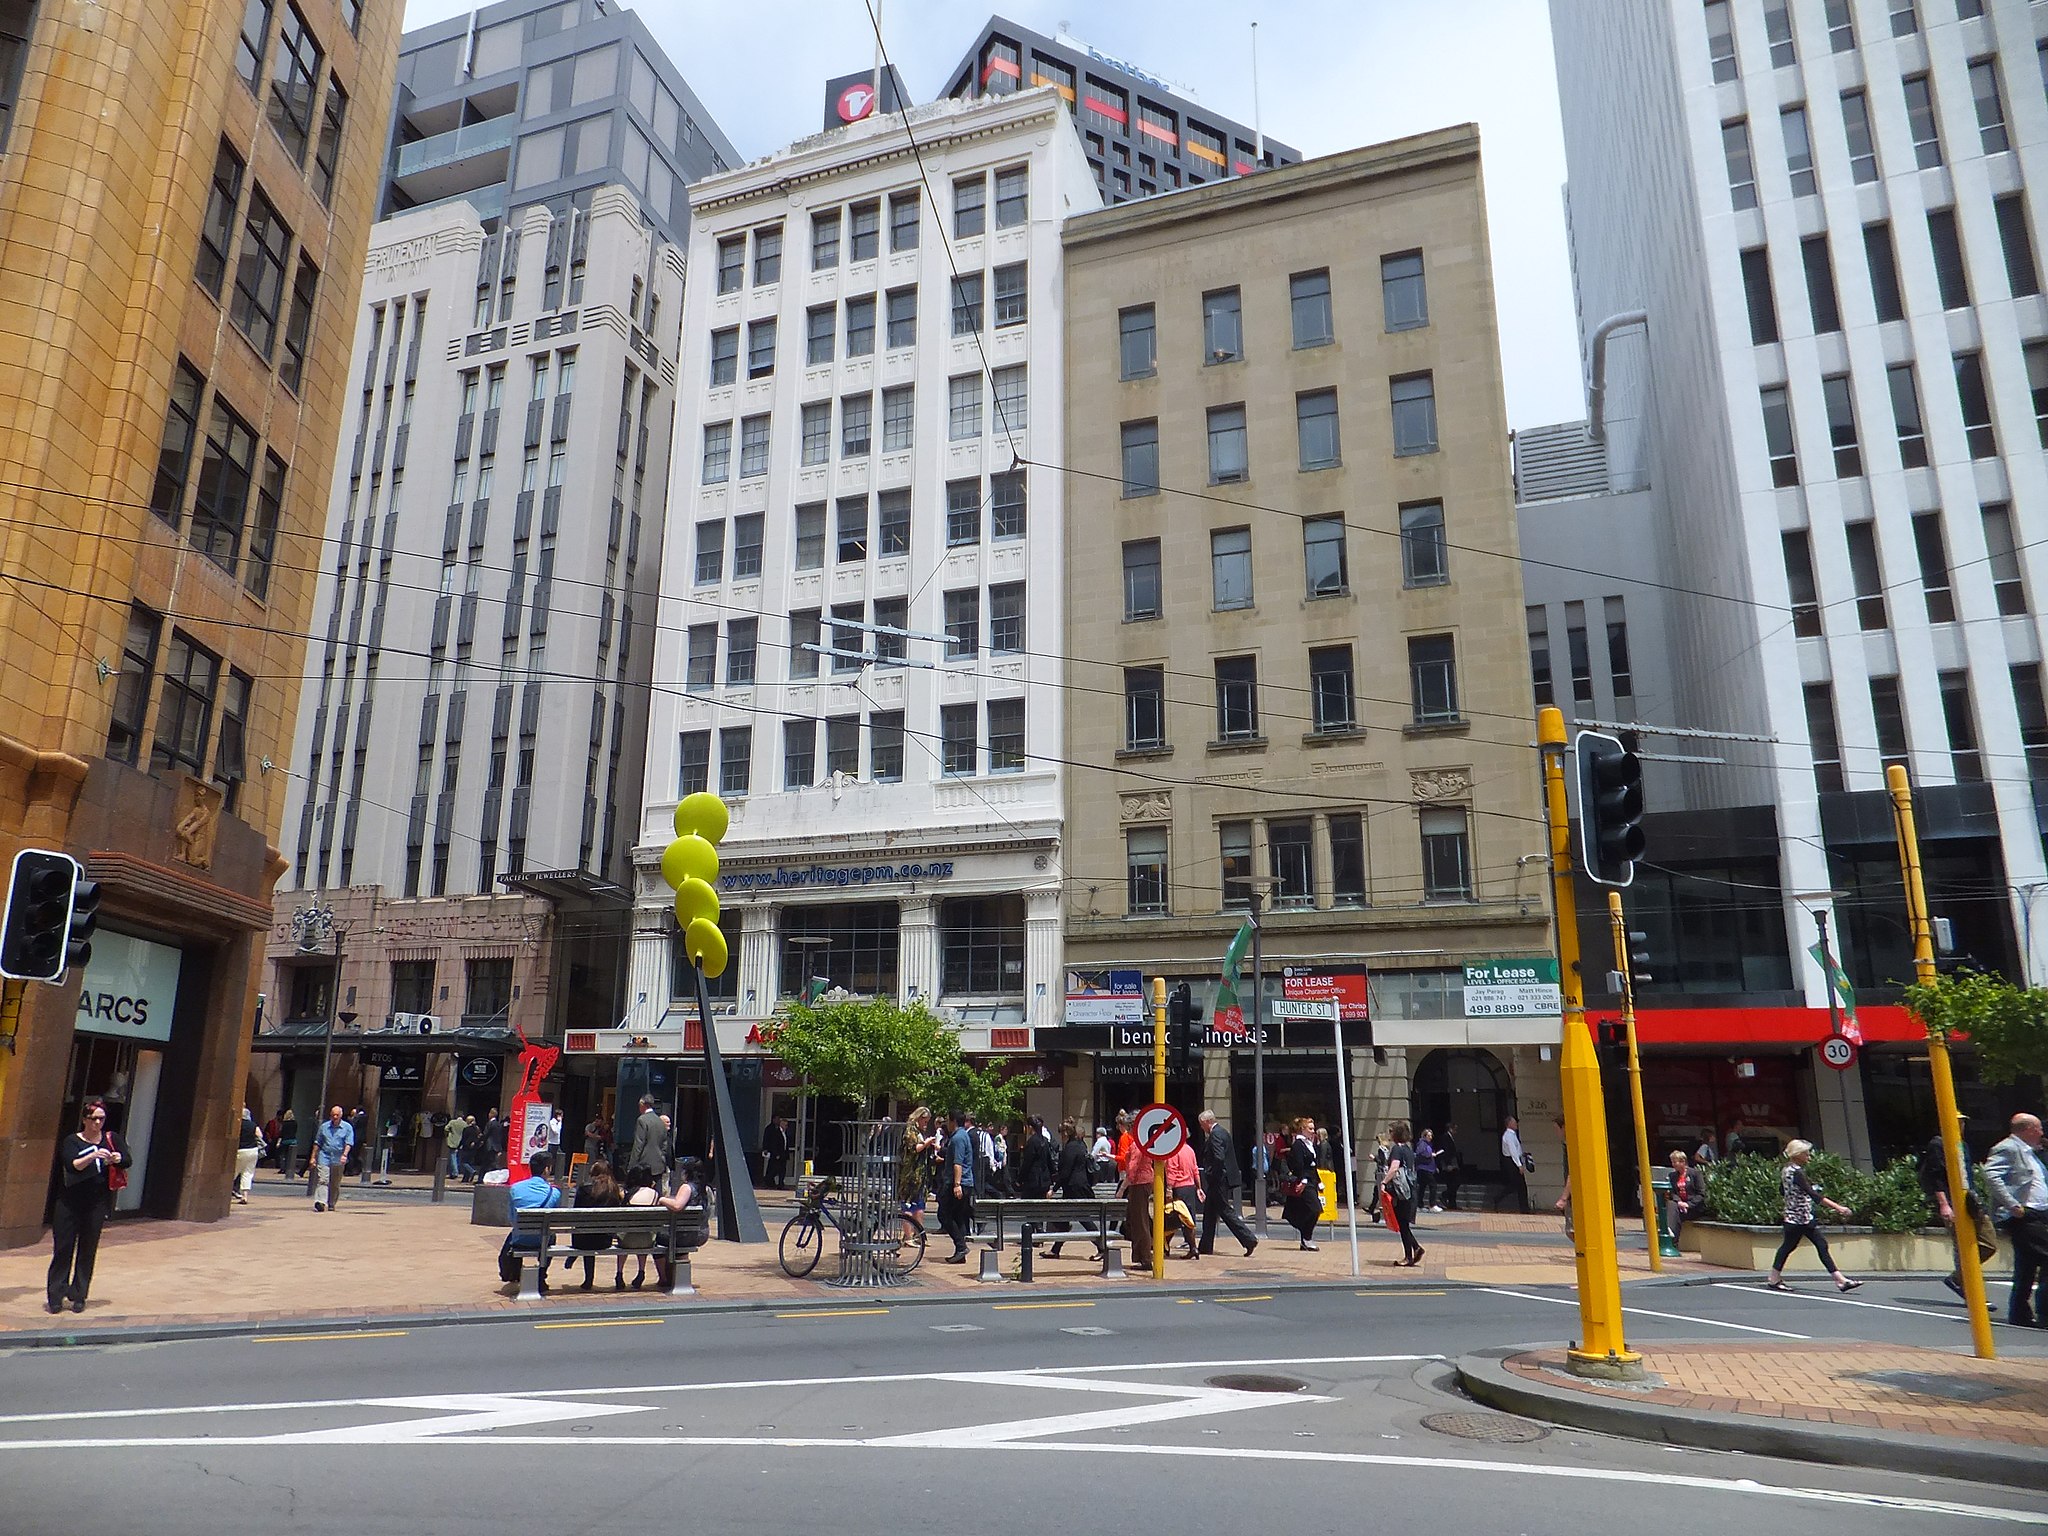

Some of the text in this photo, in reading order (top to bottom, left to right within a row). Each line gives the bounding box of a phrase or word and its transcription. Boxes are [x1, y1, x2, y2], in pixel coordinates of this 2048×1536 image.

[500, 871, 577, 882] PACIFIC JEWELLERS
[722, 862, 954, 888] www.heritagepm.co.nz
[1466, 966, 1535, 979] For Lease
[1124, 982, 1137, 990] sale
[1285, 977, 1333, 987] FOR LEASE
[1280, 1002, 1326, 1016] HUNTER ST
[1469, 1004, 1525, 1014] 499 8899
[1534, 1002, 1559, 1010] CBRE
[1827, 1044, 1849, 1059] 30
[1101, 1064, 1140, 1075] bendon
